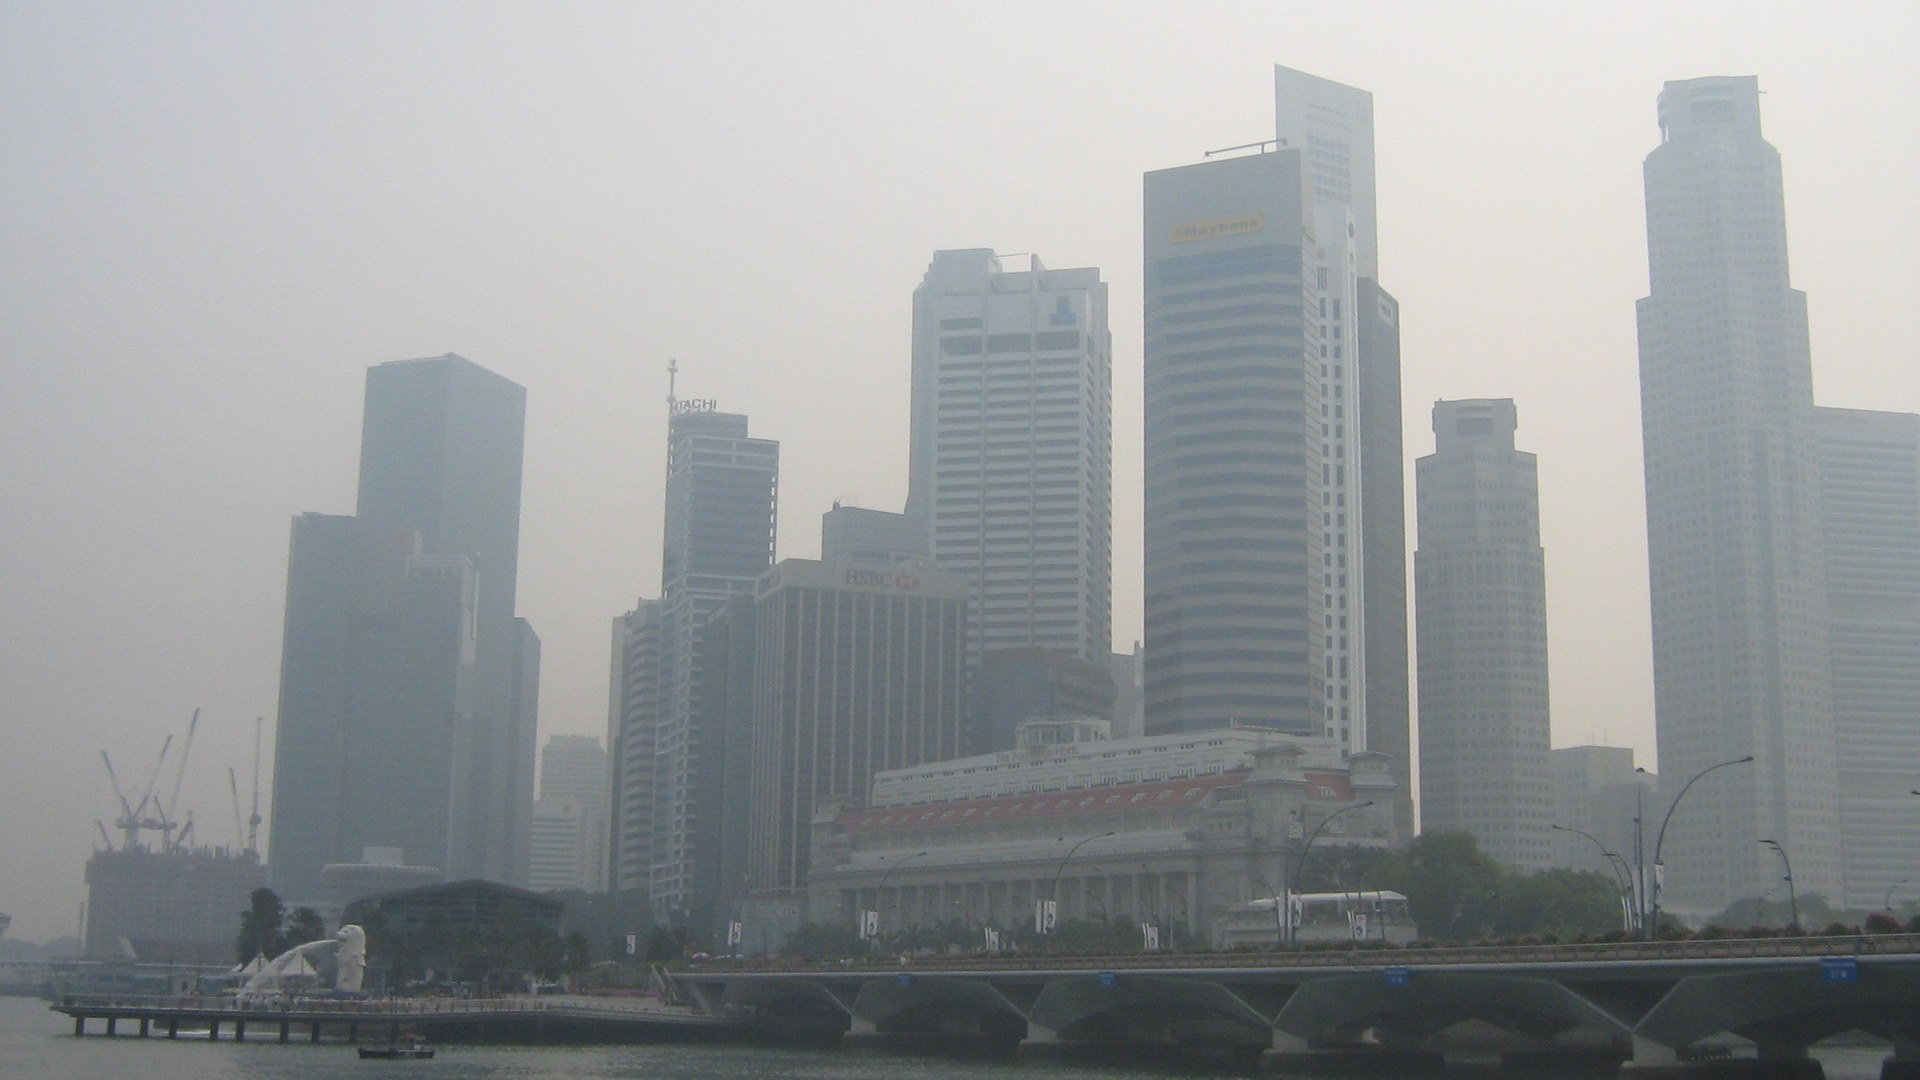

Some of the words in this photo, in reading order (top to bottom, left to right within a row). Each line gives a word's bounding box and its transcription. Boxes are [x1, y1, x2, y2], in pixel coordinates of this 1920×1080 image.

[1184, 219, 1259, 236] Maybank
[671, 399, 717, 410] ITACHI
[845, 568, 892, 588] HSBC
